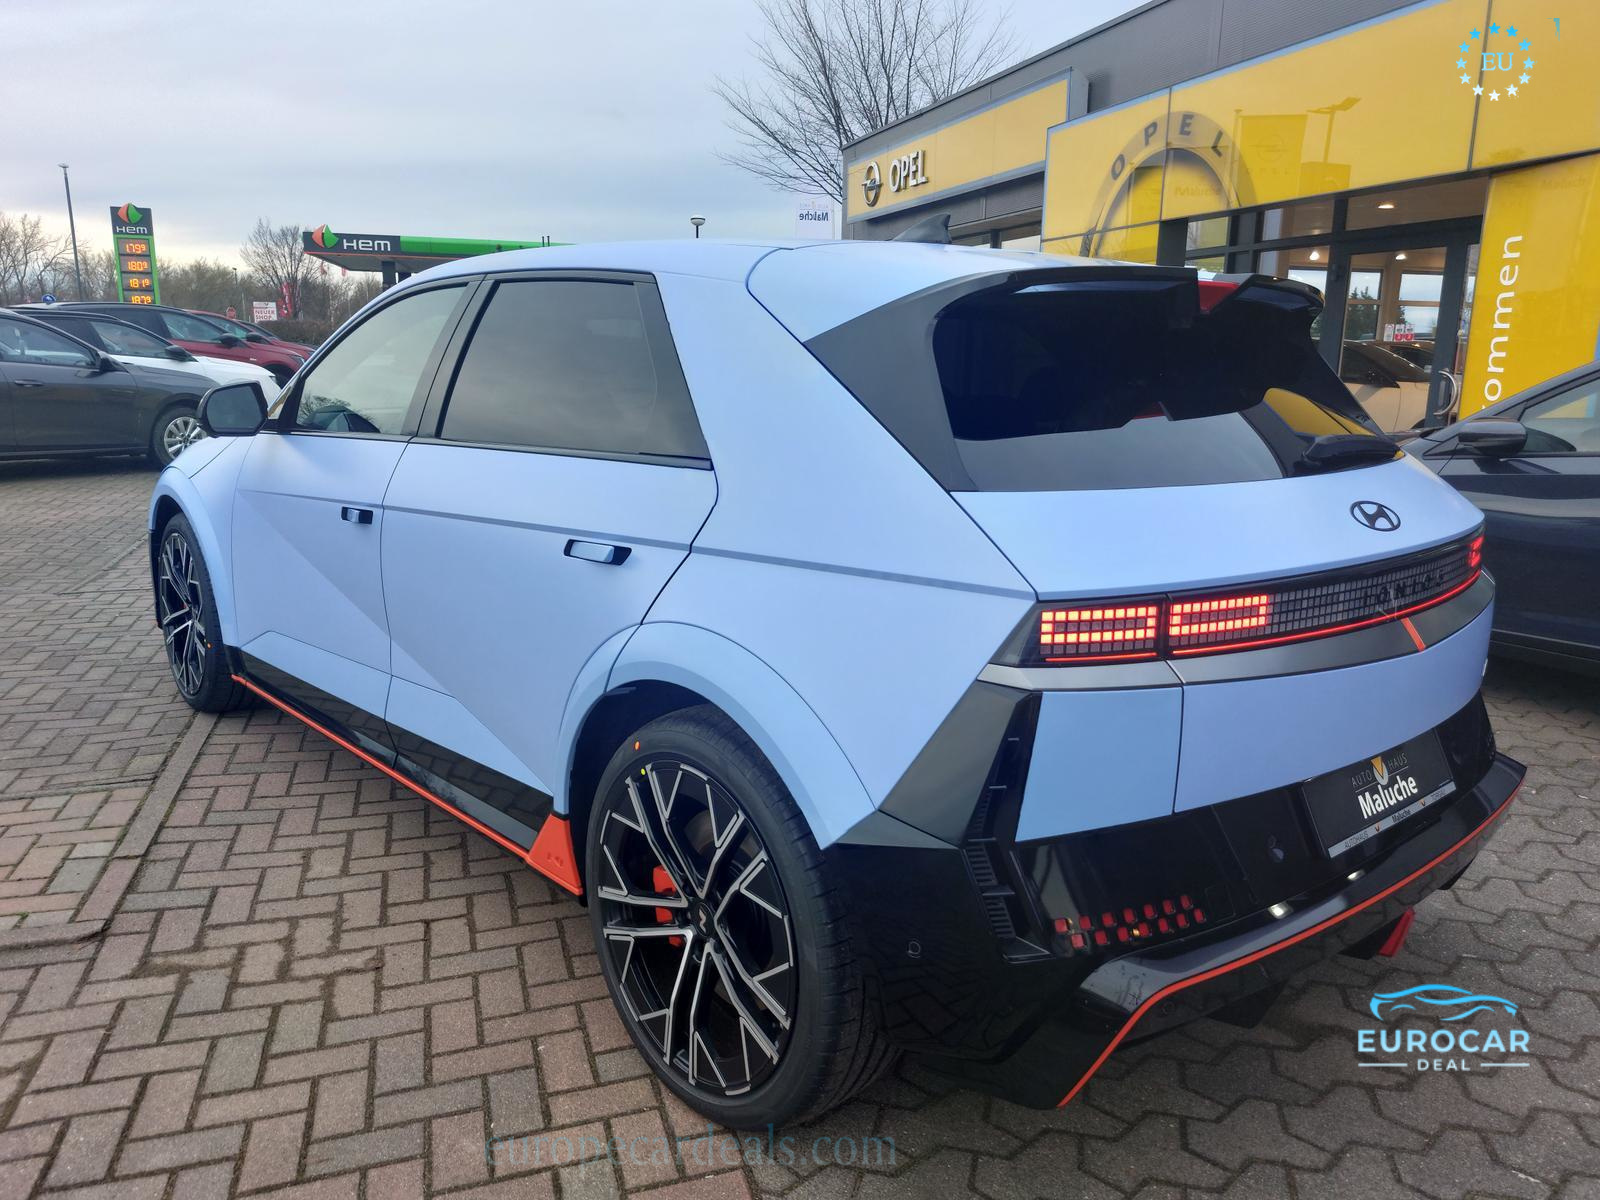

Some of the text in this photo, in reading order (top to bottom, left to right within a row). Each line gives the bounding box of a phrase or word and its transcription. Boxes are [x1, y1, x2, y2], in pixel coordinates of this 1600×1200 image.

[1111, 114, 1223, 181] OPEL
[888, 150, 928, 192] OPEL
[1481, 235, 1523, 410] ommen
[1351, 752, 1408, 787] AUTO HAUS
[1357, 775, 1419, 819] Maluche
